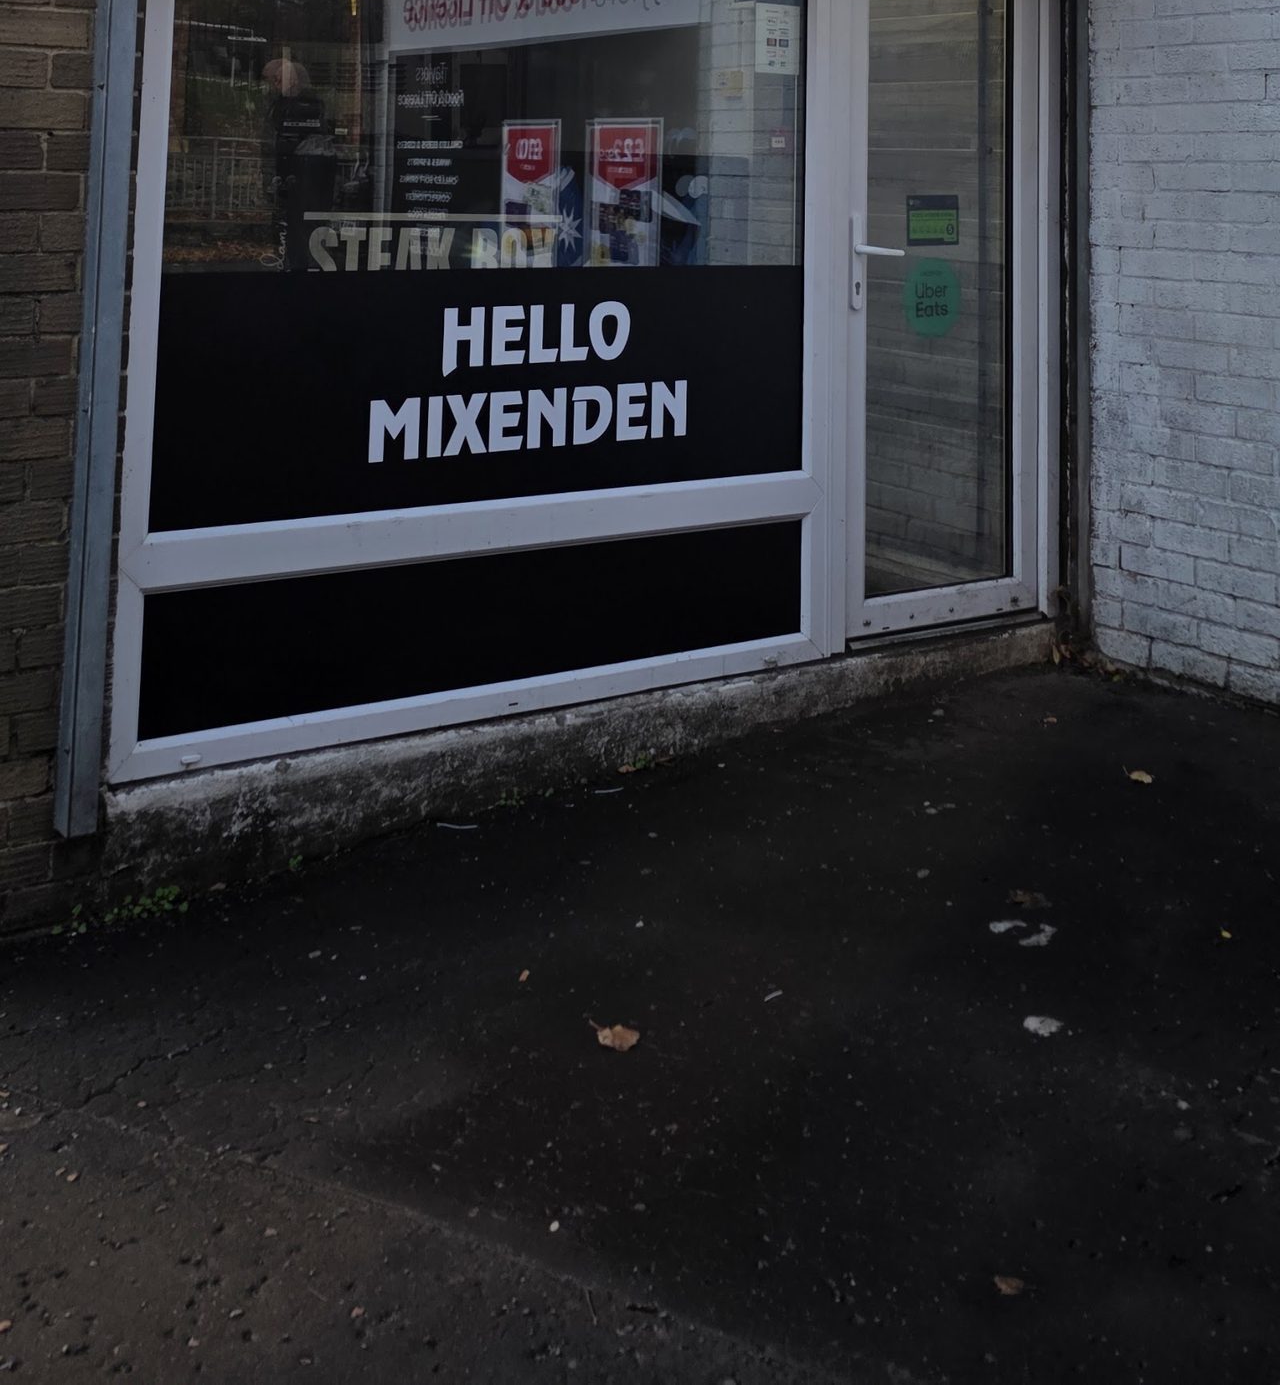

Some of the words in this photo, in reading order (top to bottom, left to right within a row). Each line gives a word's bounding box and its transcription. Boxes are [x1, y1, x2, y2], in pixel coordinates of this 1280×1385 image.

[914, 279, 949, 299] Uber
[915, 301, 949, 318] Eats
[442, 300, 631, 377] HELLO
[368, 379, 688, 464] MIXENDEN
